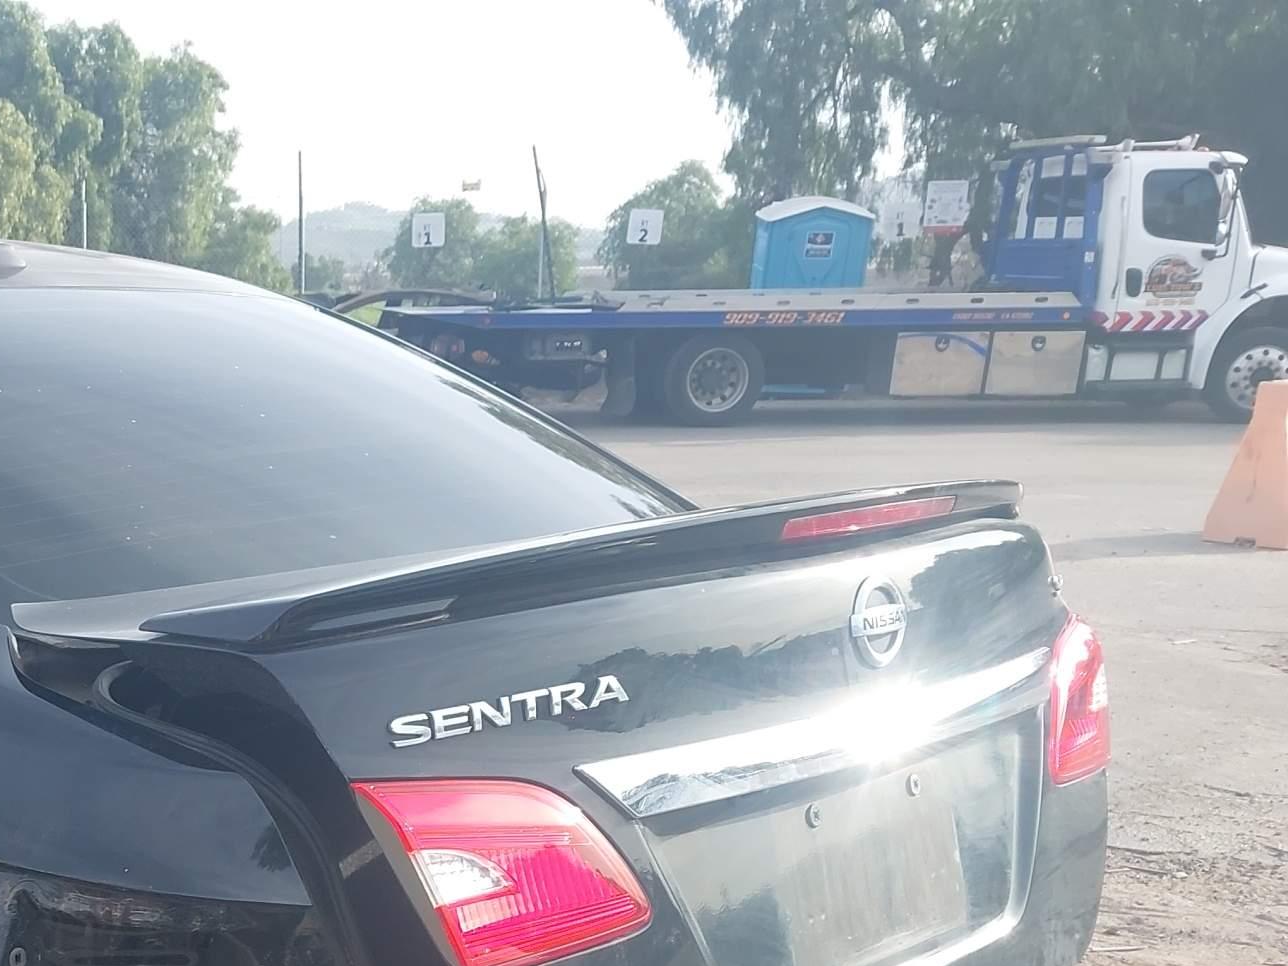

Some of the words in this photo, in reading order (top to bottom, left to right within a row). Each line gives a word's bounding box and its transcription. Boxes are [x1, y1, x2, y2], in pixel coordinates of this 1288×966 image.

[638, 228, 648, 242] 2
[896, 222, 905, 237] 1
[423, 231, 432, 245] 1
[386, 674, 630, 749] SENTRA
